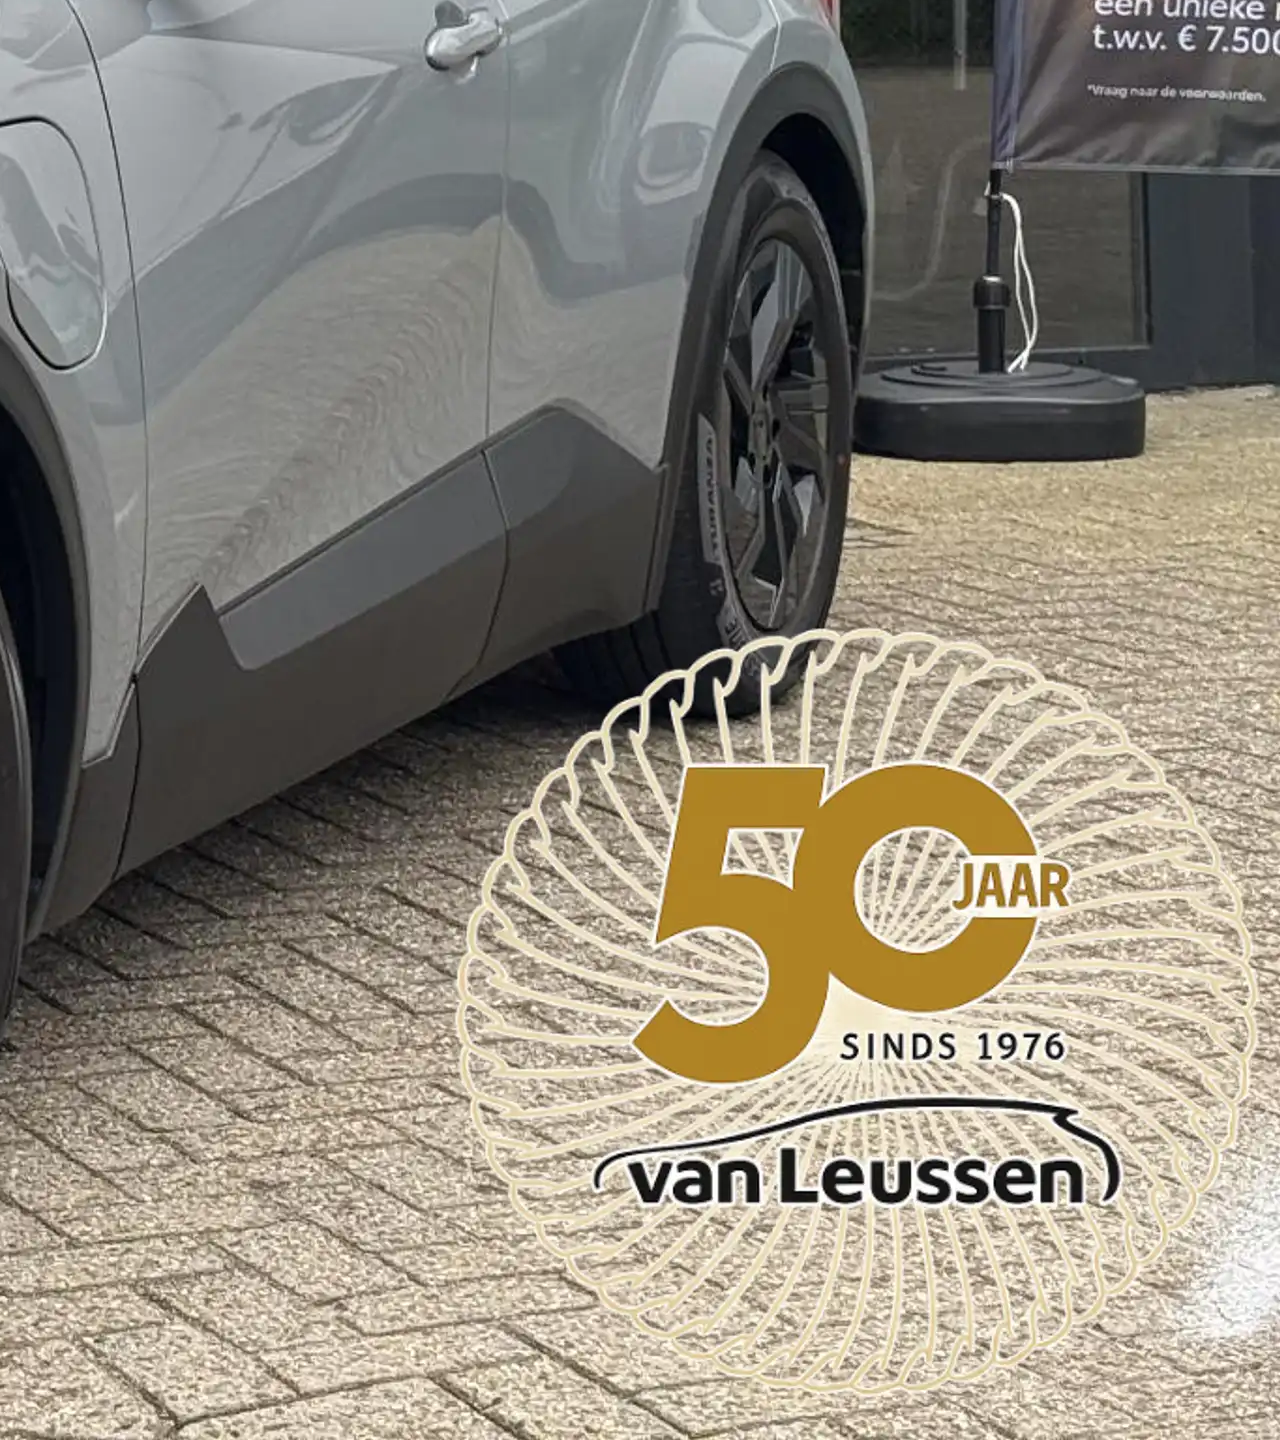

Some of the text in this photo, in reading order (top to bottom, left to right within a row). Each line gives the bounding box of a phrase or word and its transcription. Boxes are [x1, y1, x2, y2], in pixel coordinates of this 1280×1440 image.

[1093, 24, 1167, 50] t.w.v.
[1178, 24, 1198, 51] €
[1130, 87, 1158, 97] naar
[1160, 85, 1176, 97] de
